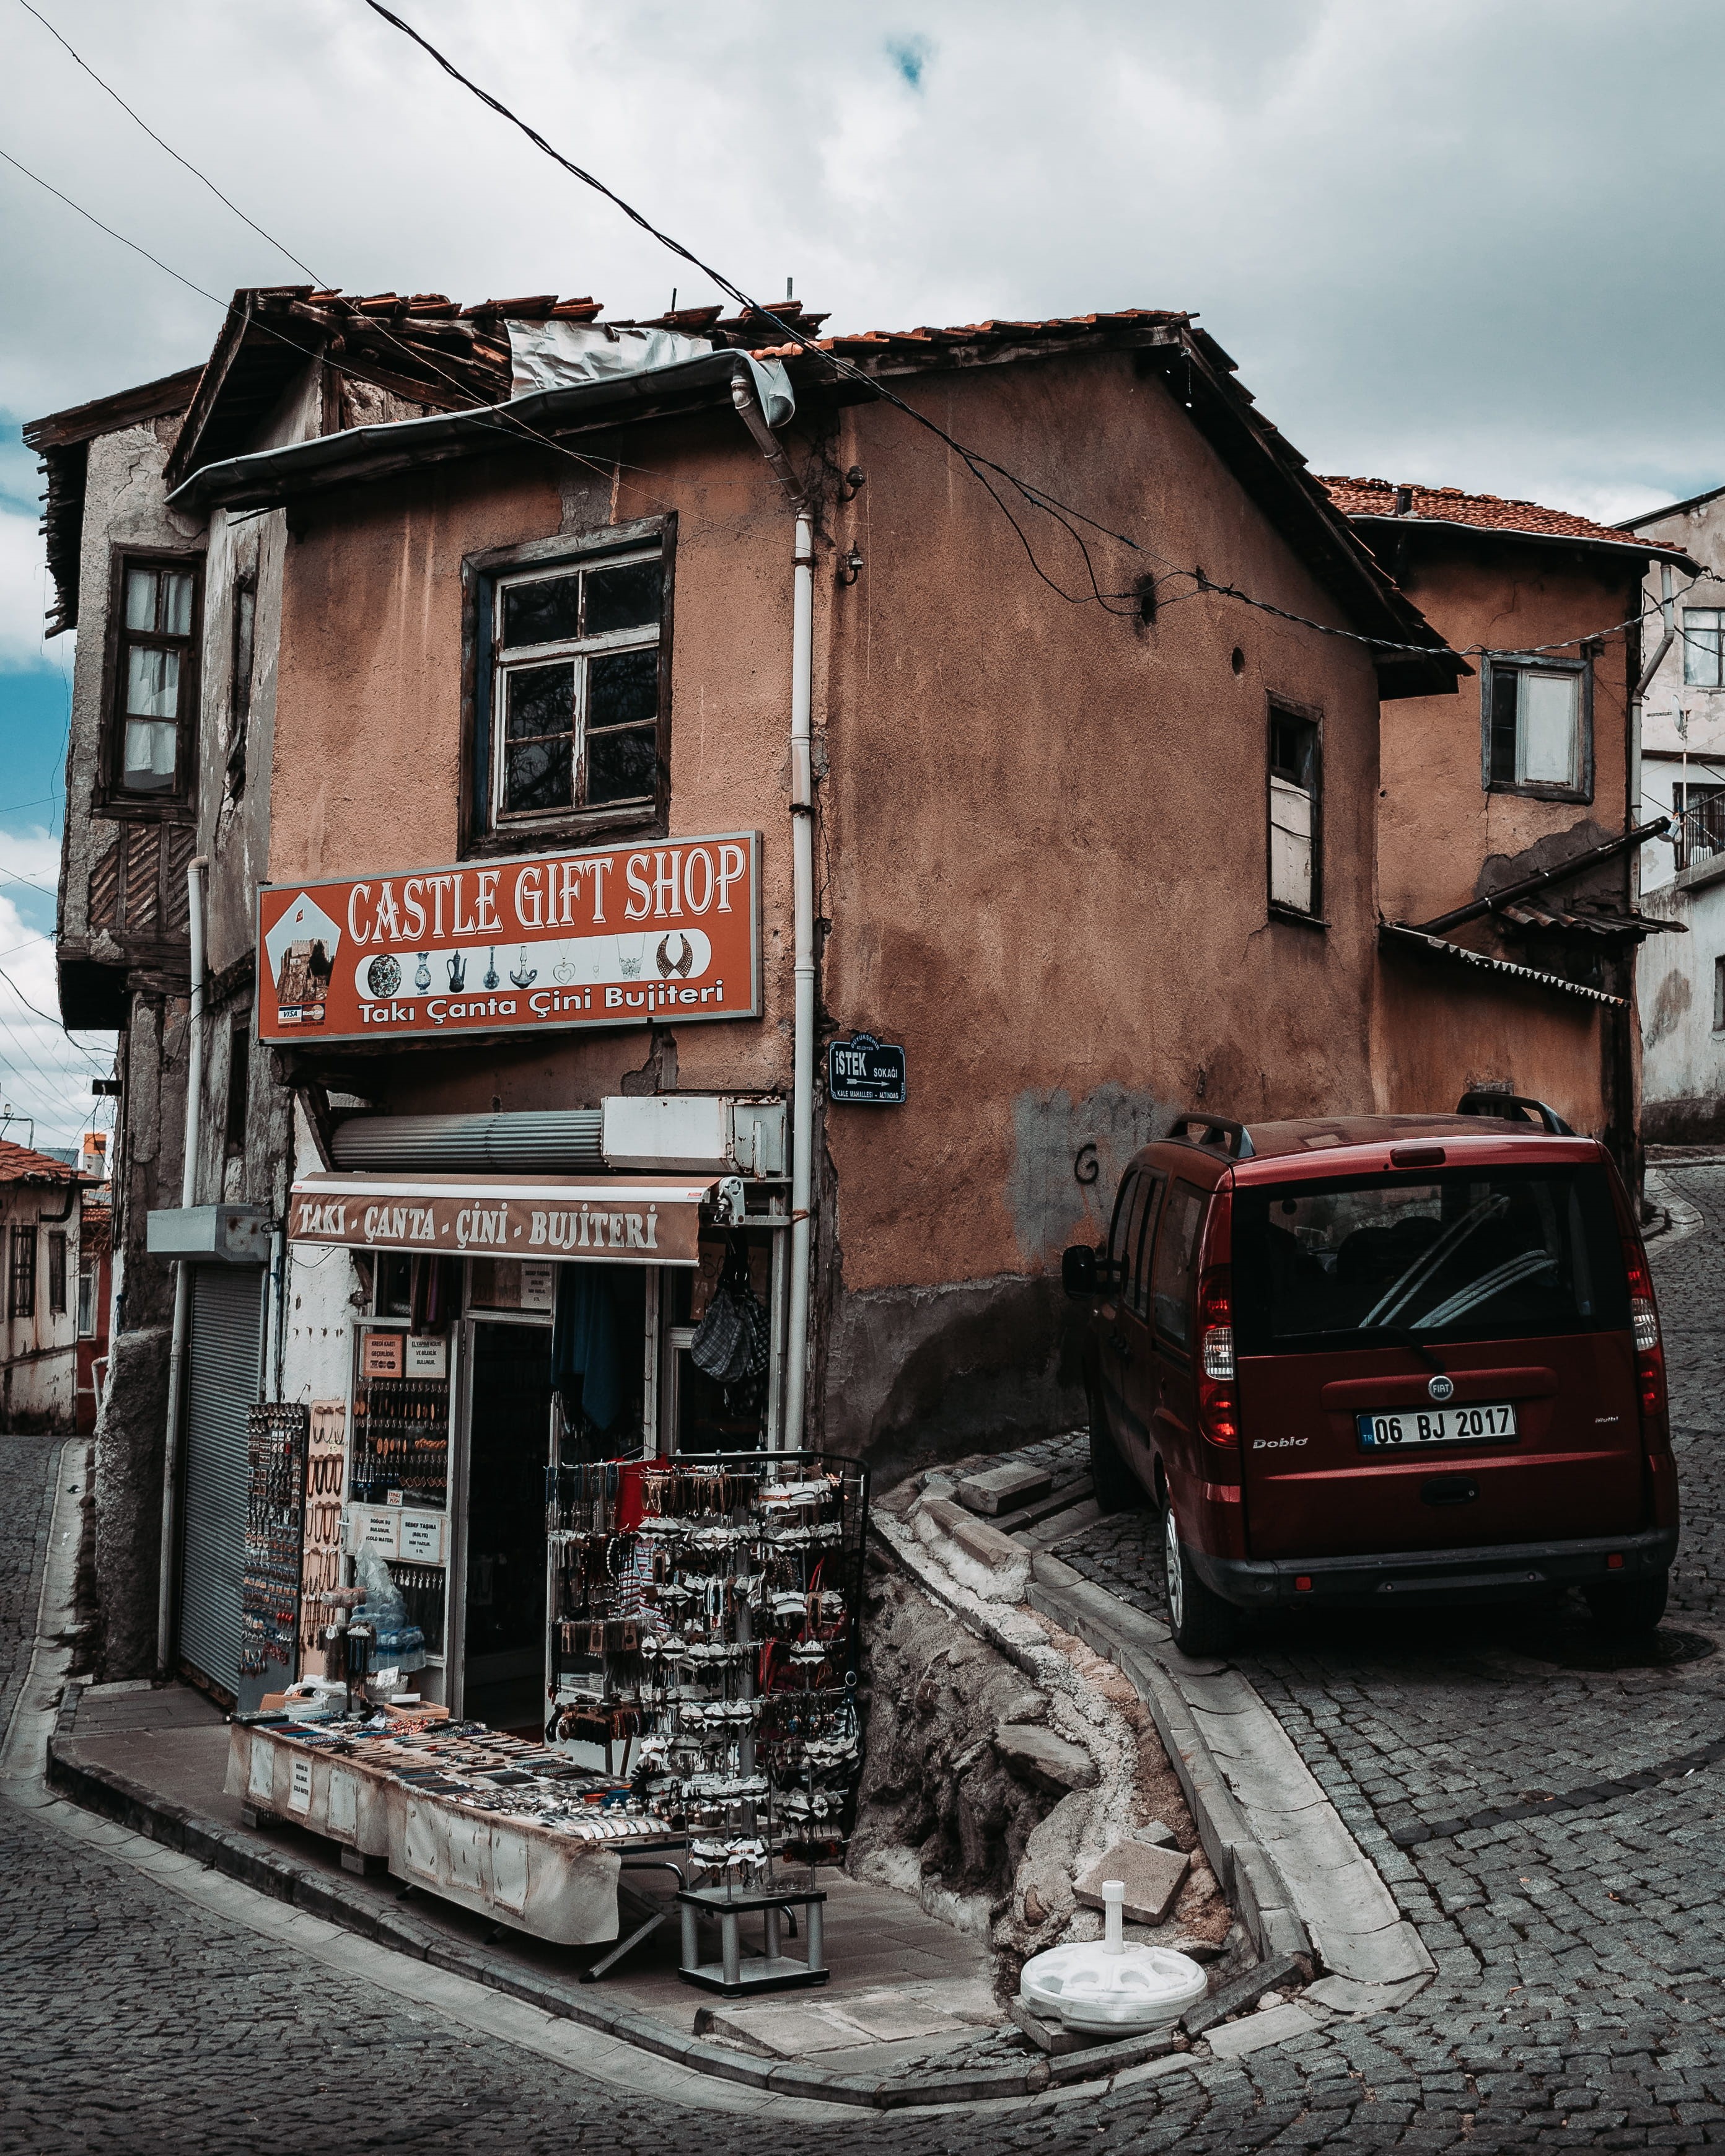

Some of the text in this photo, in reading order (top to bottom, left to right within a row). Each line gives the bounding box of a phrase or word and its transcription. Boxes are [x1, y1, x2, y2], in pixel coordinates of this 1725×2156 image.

[347, 844, 745, 946] CASTLE GIFT SHOP
[358, 979, 724, 1025] Takı Çanta Çini Bujiteri
[835, 1050, 867, 1076] İSTEK
[299, 1203, 346, 1235] TAKI
[363, 1205, 436, 1245] ÇANTA
[456, 1201, 508, 1248] ÇİNİ
[530, 1203, 658, 1249] BUJİTERİ
[1433, 1384, 1449, 1393] FIAT
[1374, 1417, 1403, 1444] 06
[1417, 1413, 1446, 1440] BJ
[1455, 1408, 1509, 1437] 2017
